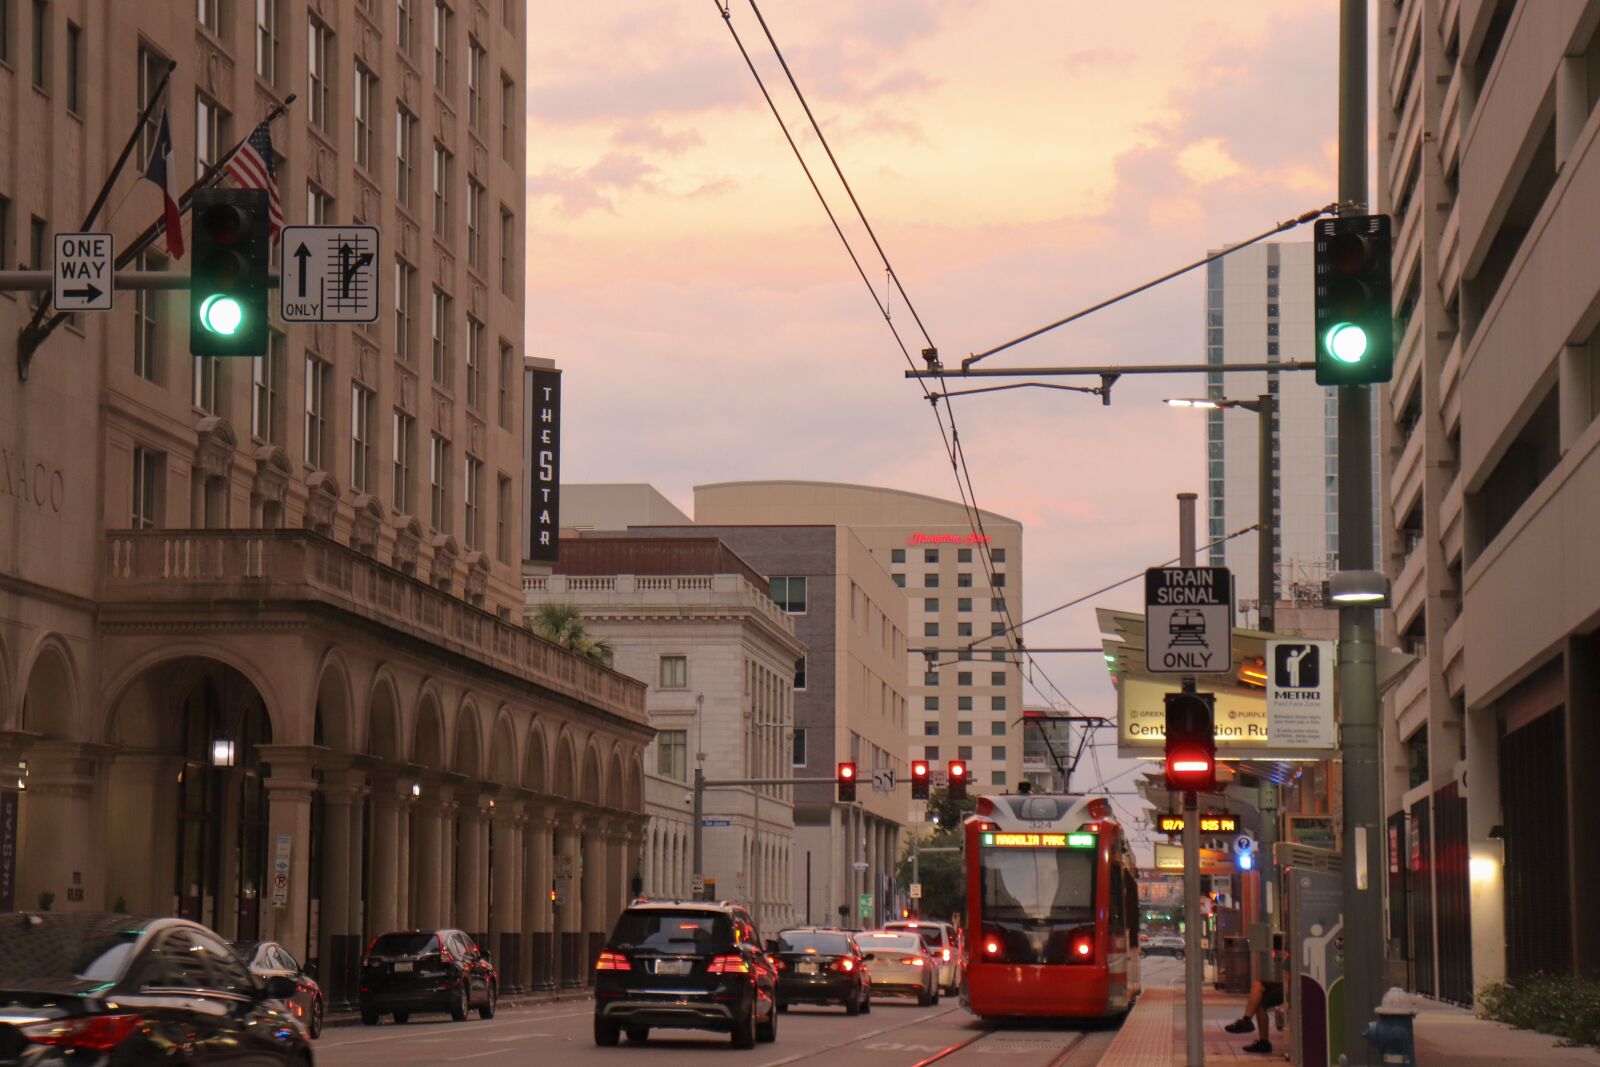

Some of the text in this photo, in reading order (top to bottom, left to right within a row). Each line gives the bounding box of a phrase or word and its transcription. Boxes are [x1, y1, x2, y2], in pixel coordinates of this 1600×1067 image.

[62, 240, 105, 258] ONE
[61, 261, 106, 279] WAY
[286, 303, 319, 316] ONLY
[1163, 569, 1214, 586] TRAIN
[1157, 587, 1219, 604] SIGNAL
[1163, 653, 1213, 668] ONLY
[1275, 691, 1320, 700] METRO
[1238, 711, 1267, 719] PURPLE
[1129, 723, 1166, 736] Cent
[1214, 724, 1243, 736] tion
[1029, 821, 1052, 829] 324
[1221, 820, 1234, 830] PM
[996, 834, 1039, 845] MAGNOLIA
[1042, 834, 1066, 846] PARK
